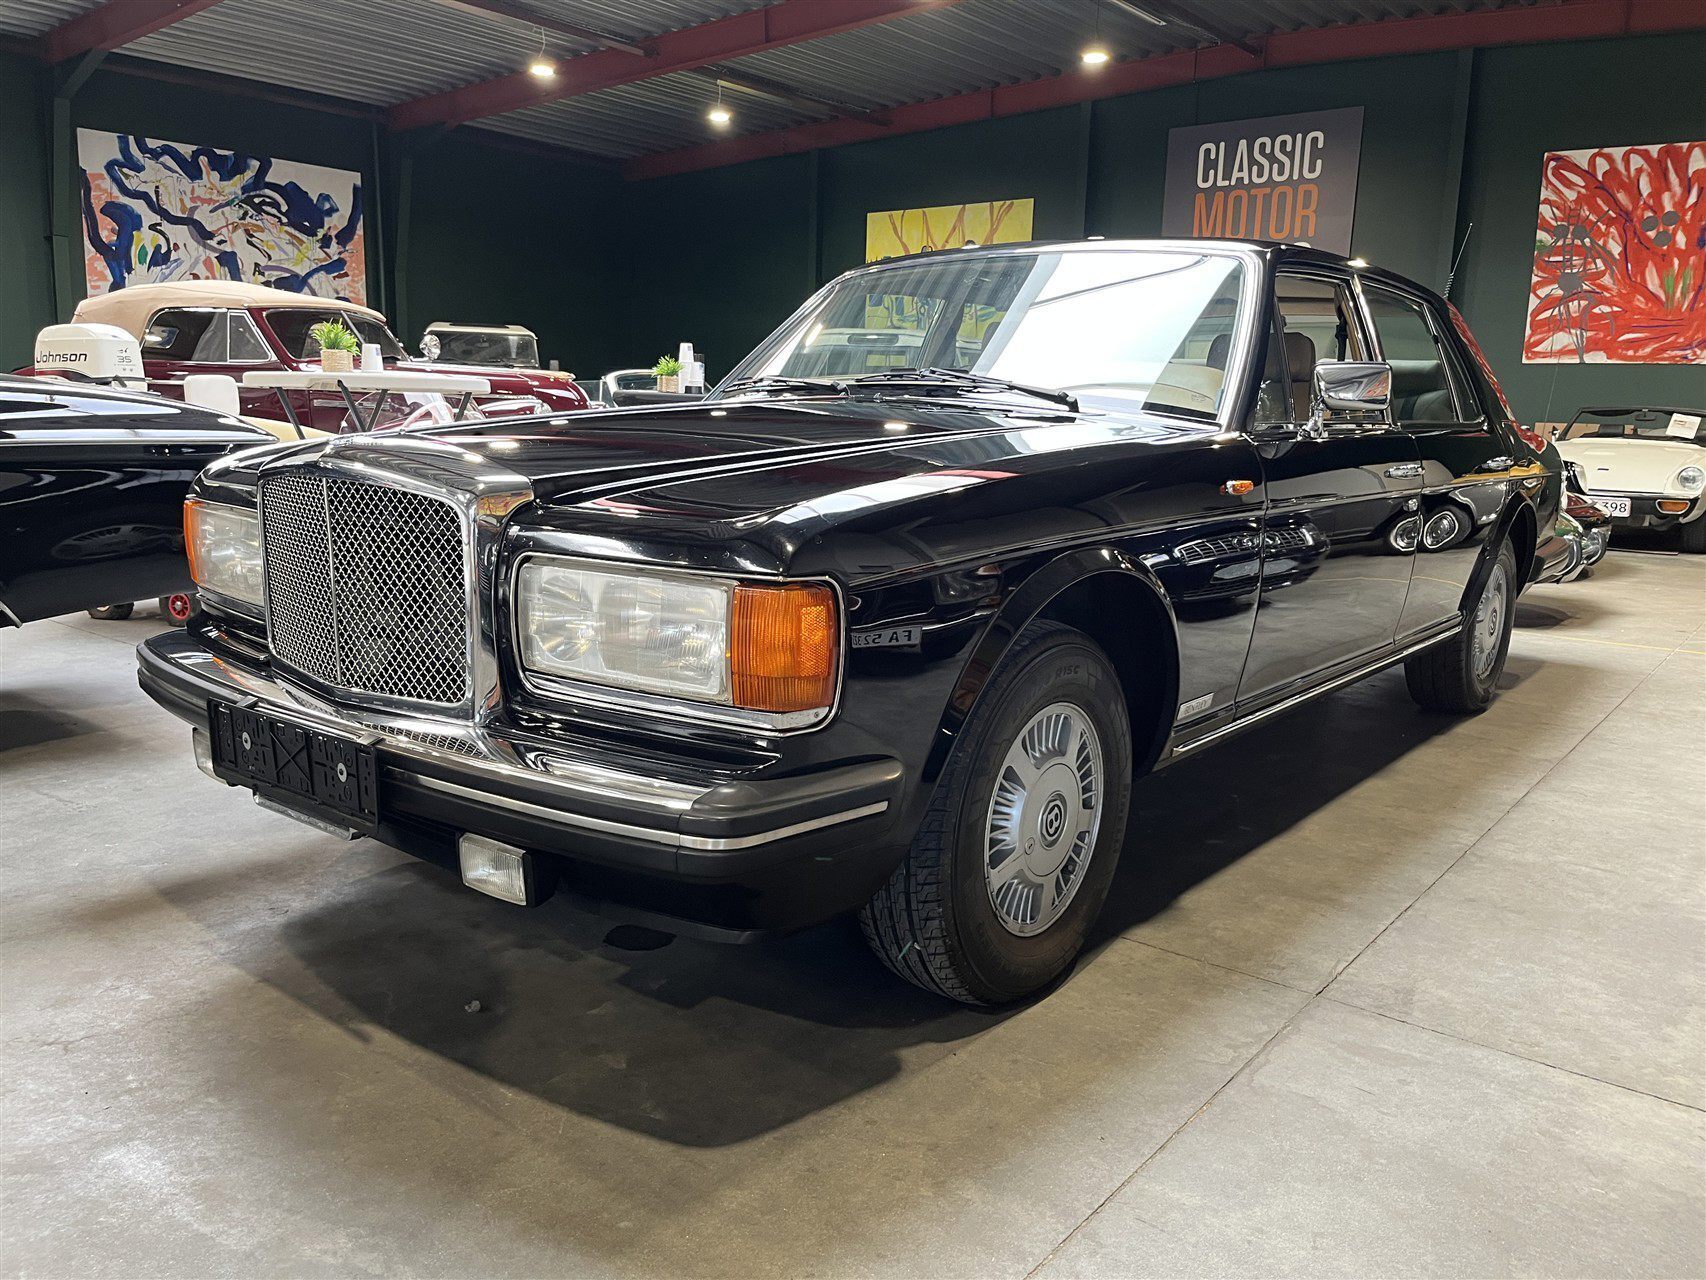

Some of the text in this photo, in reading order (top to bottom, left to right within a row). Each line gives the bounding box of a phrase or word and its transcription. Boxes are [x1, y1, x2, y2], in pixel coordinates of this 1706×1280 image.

[1197, 131, 1324, 188] CLASSIC
[1193, 184, 1319, 239] MOTOR
[36, 351, 87, 363] Johnson
